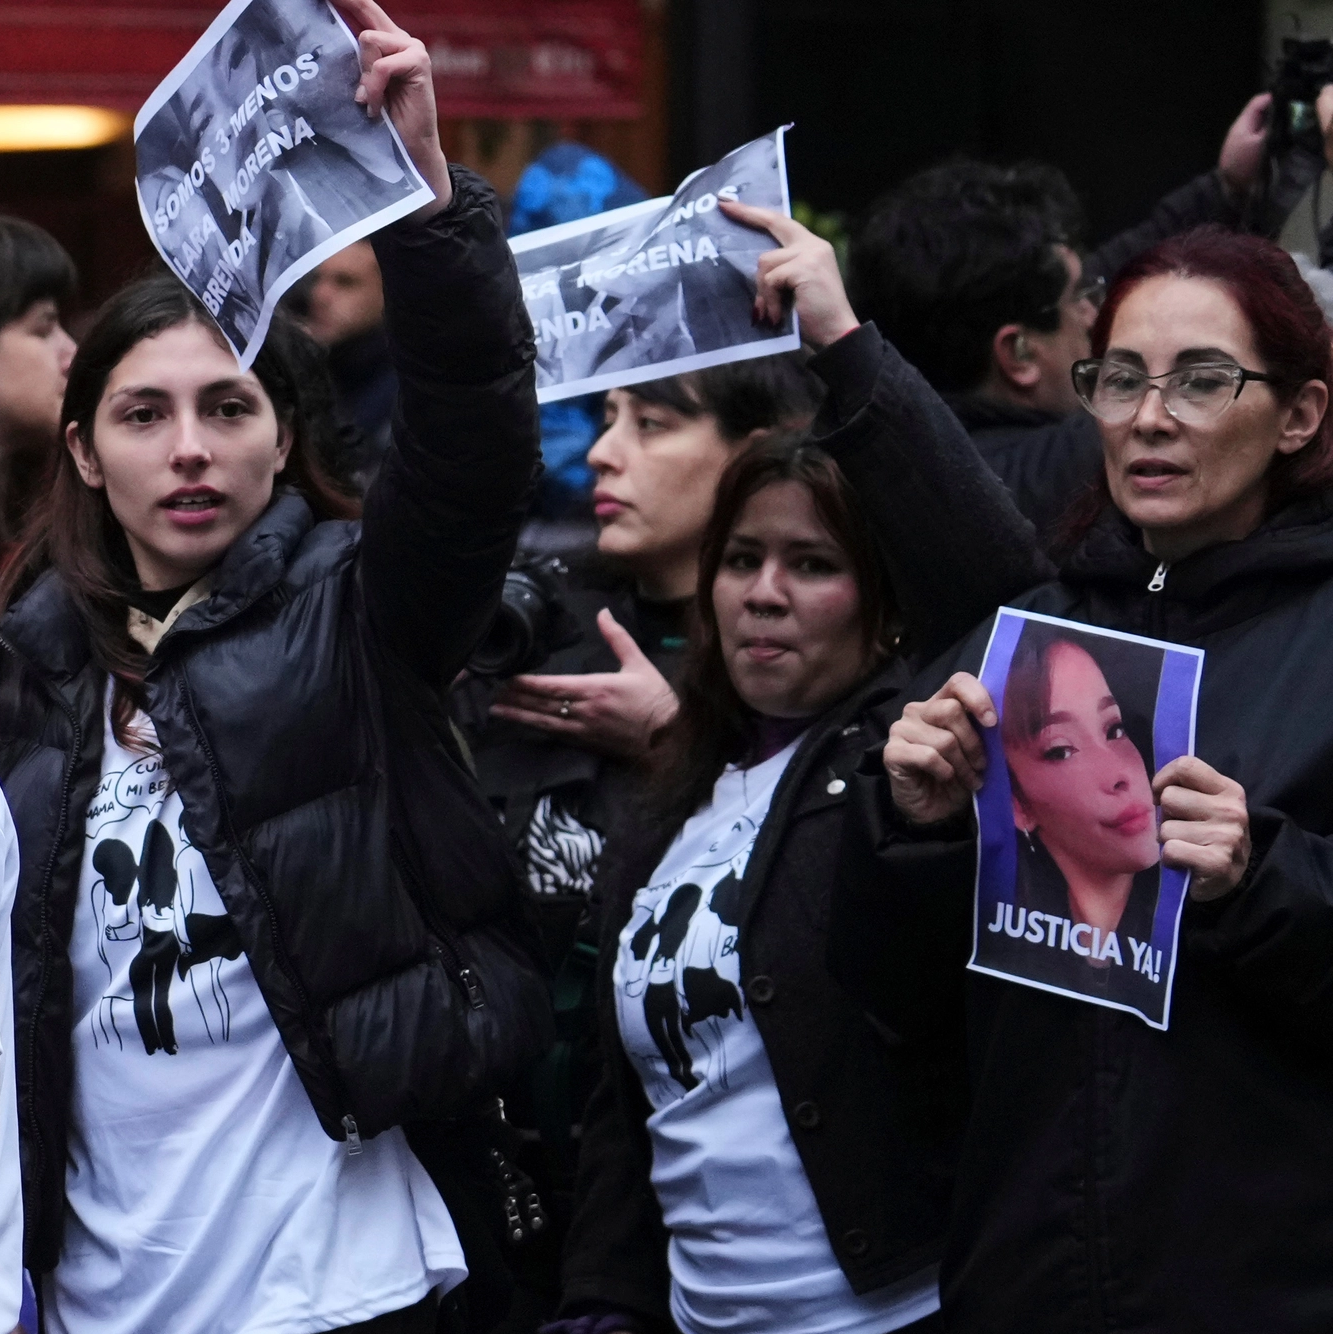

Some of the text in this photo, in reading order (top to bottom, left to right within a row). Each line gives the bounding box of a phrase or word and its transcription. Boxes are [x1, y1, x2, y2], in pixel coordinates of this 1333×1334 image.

[154, 52, 320, 235] SOMOS 3 MENOS
[172, 116, 316, 280] LARA MORENA
[651, 185, 740, 236] ENOS
[200, 227, 258, 318] BRENDA
[576, 236, 720, 289] MORENA
[126, 784, 143, 797] MI
[988, 901, 1163, 984] JUSTICIA YA!
